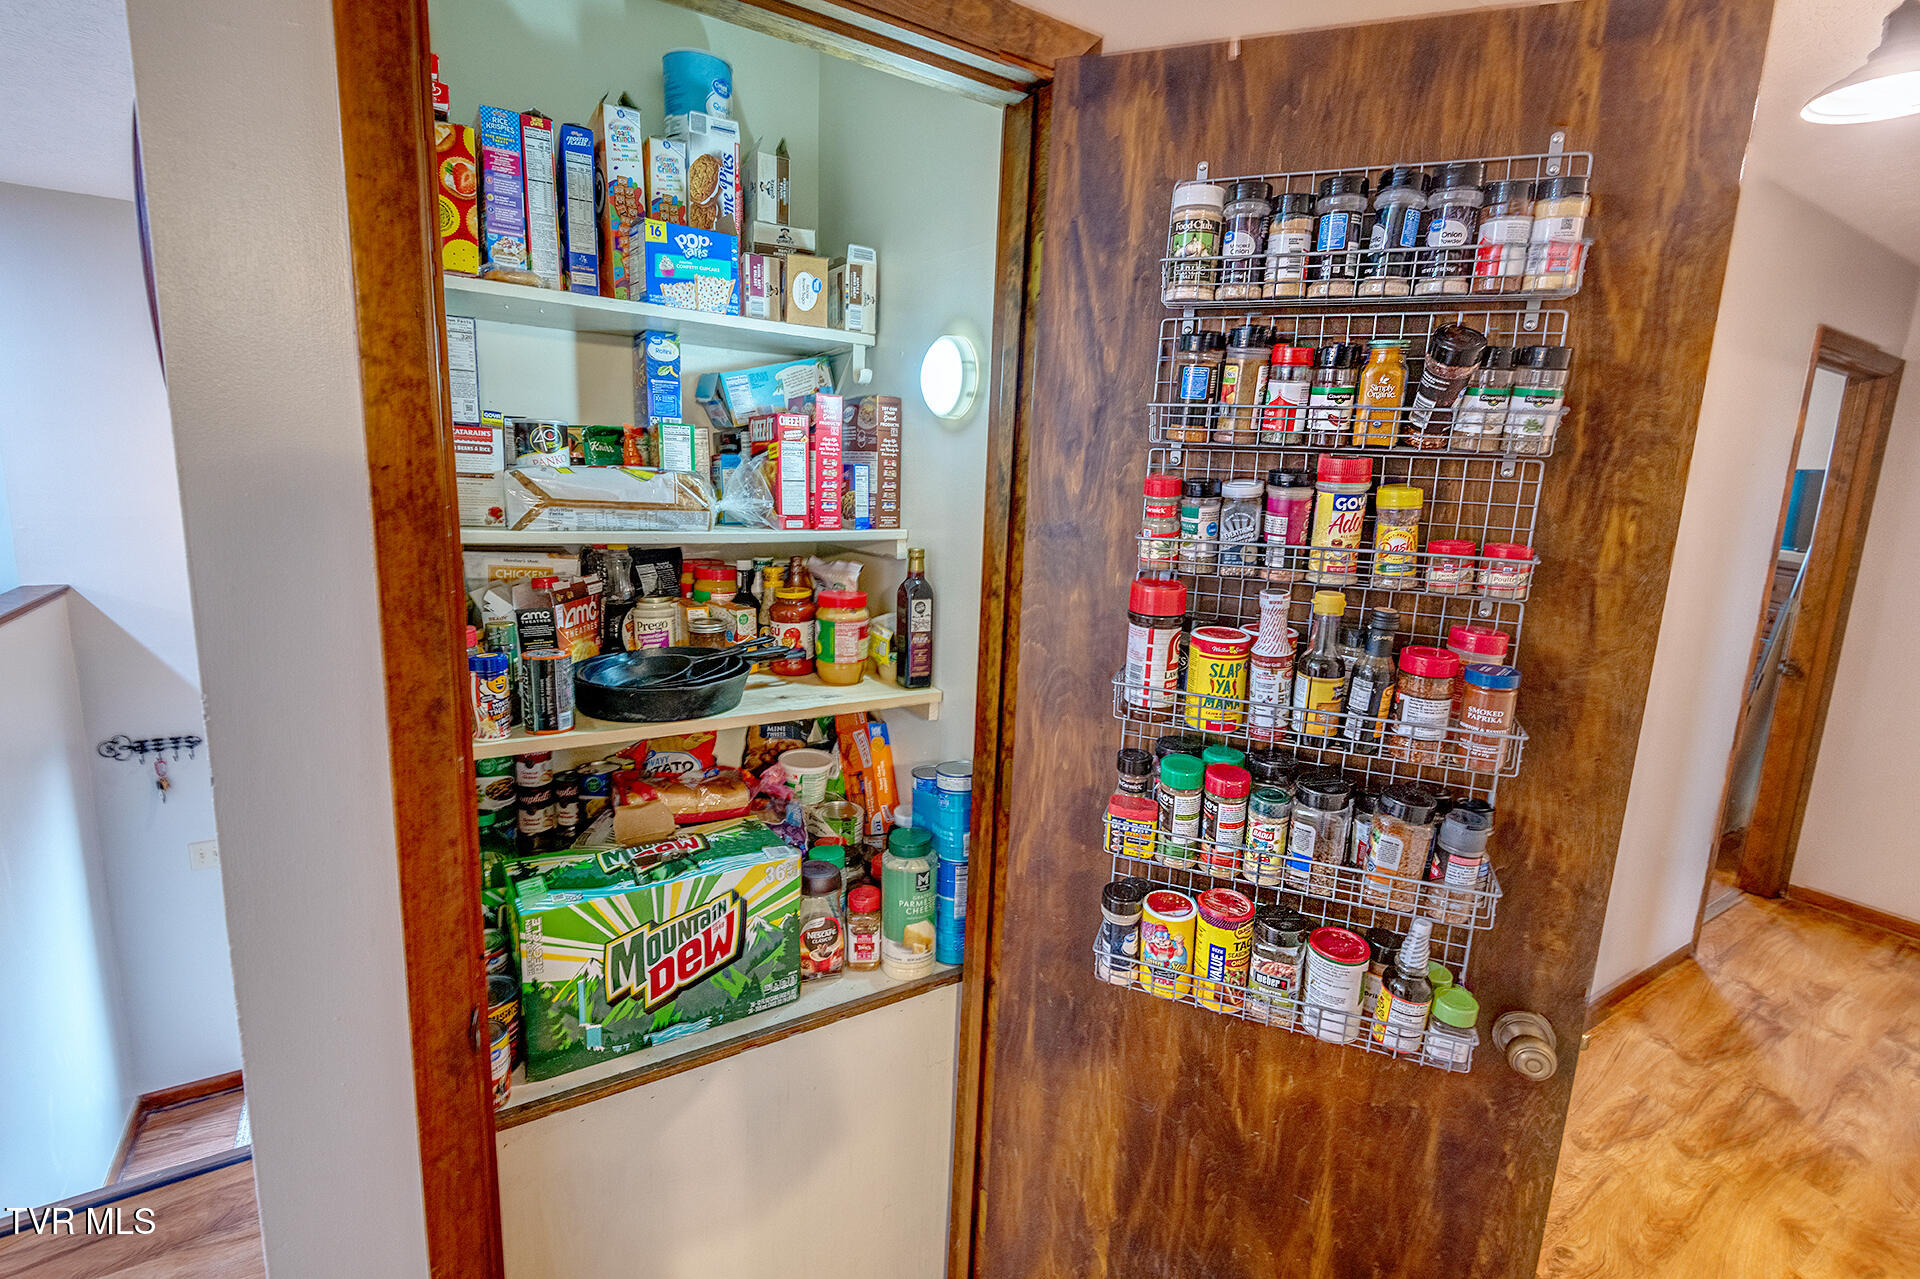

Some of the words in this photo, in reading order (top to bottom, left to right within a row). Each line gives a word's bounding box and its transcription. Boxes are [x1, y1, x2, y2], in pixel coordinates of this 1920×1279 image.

[485, 121, 515, 135] KRISPIES
[492, 116, 508, 126] RICE
[719, 153, 735, 190] Pies
[649, 224, 662, 238] 16
[1175, 220, 1194, 233] Food
[1194, 219, 1213, 231] Club
[1441, 231, 1463, 239] Onion
[1369, 383, 1396, 392] Simply
[1366, 390, 1397, 400] Organic
[1379, 536, 1414, 559] Dash
[495, 569, 548, 579] CHICKEN
[636, 620, 669, 633] Prego
[1209, 663, 1242, 678] SLAP
[1216, 679, 1231, 695] YA
[1203, 693, 1241, 710] MAMA
[1467, 706, 1504, 718] SMOKED
[1467, 712, 1503, 724] PAPRIKA
[766, 725, 786, 733] MINI
[1252, 828, 1274, 841] BADIA
[765, 865, 785, 885] 36
[531, 917, 544, 974] RECYCLE
[1209, 954, 1225, 982] VALUE
[1256, 973, 1281, 988] weber
